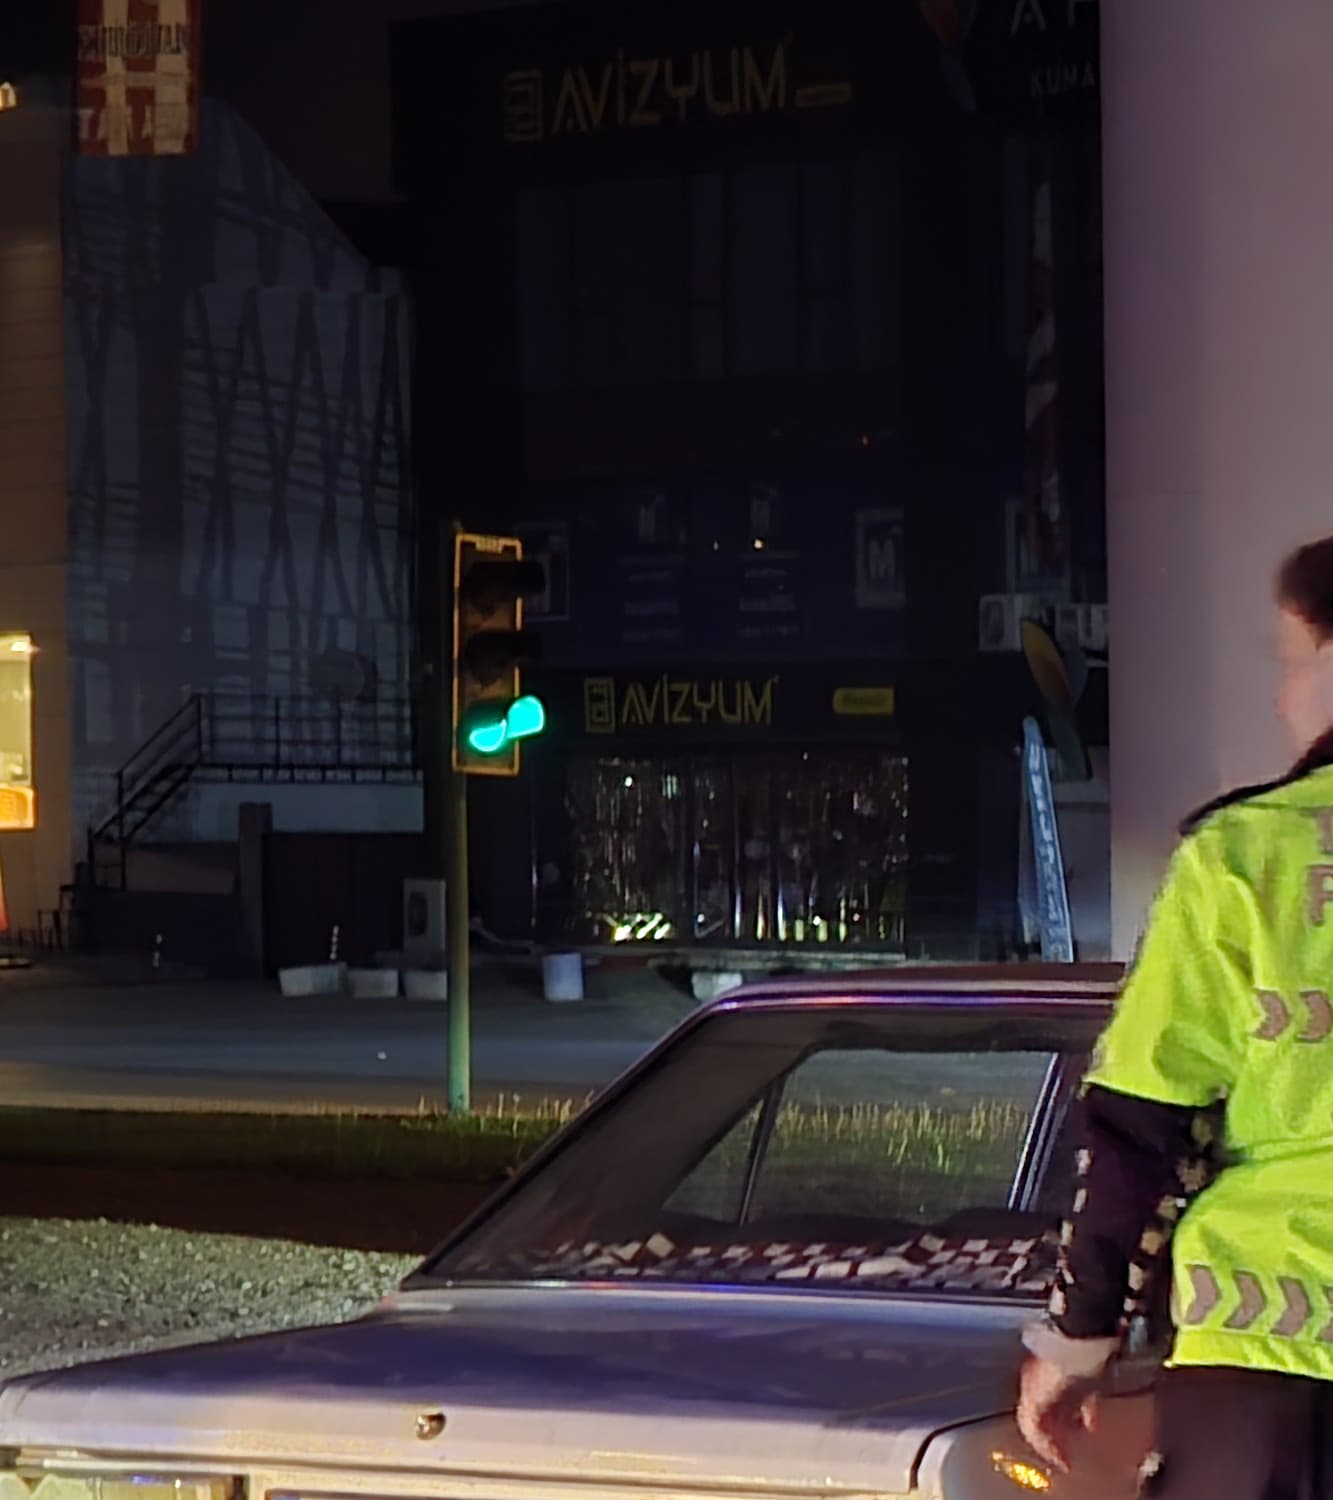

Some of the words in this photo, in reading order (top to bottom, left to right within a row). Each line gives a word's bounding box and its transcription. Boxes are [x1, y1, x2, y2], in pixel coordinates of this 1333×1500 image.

[550, 43, 786, 136] AVİZYUM
[1030, 58, 1097, 97] KUMA
[621, 673, 773, 728] AVİZYUM
